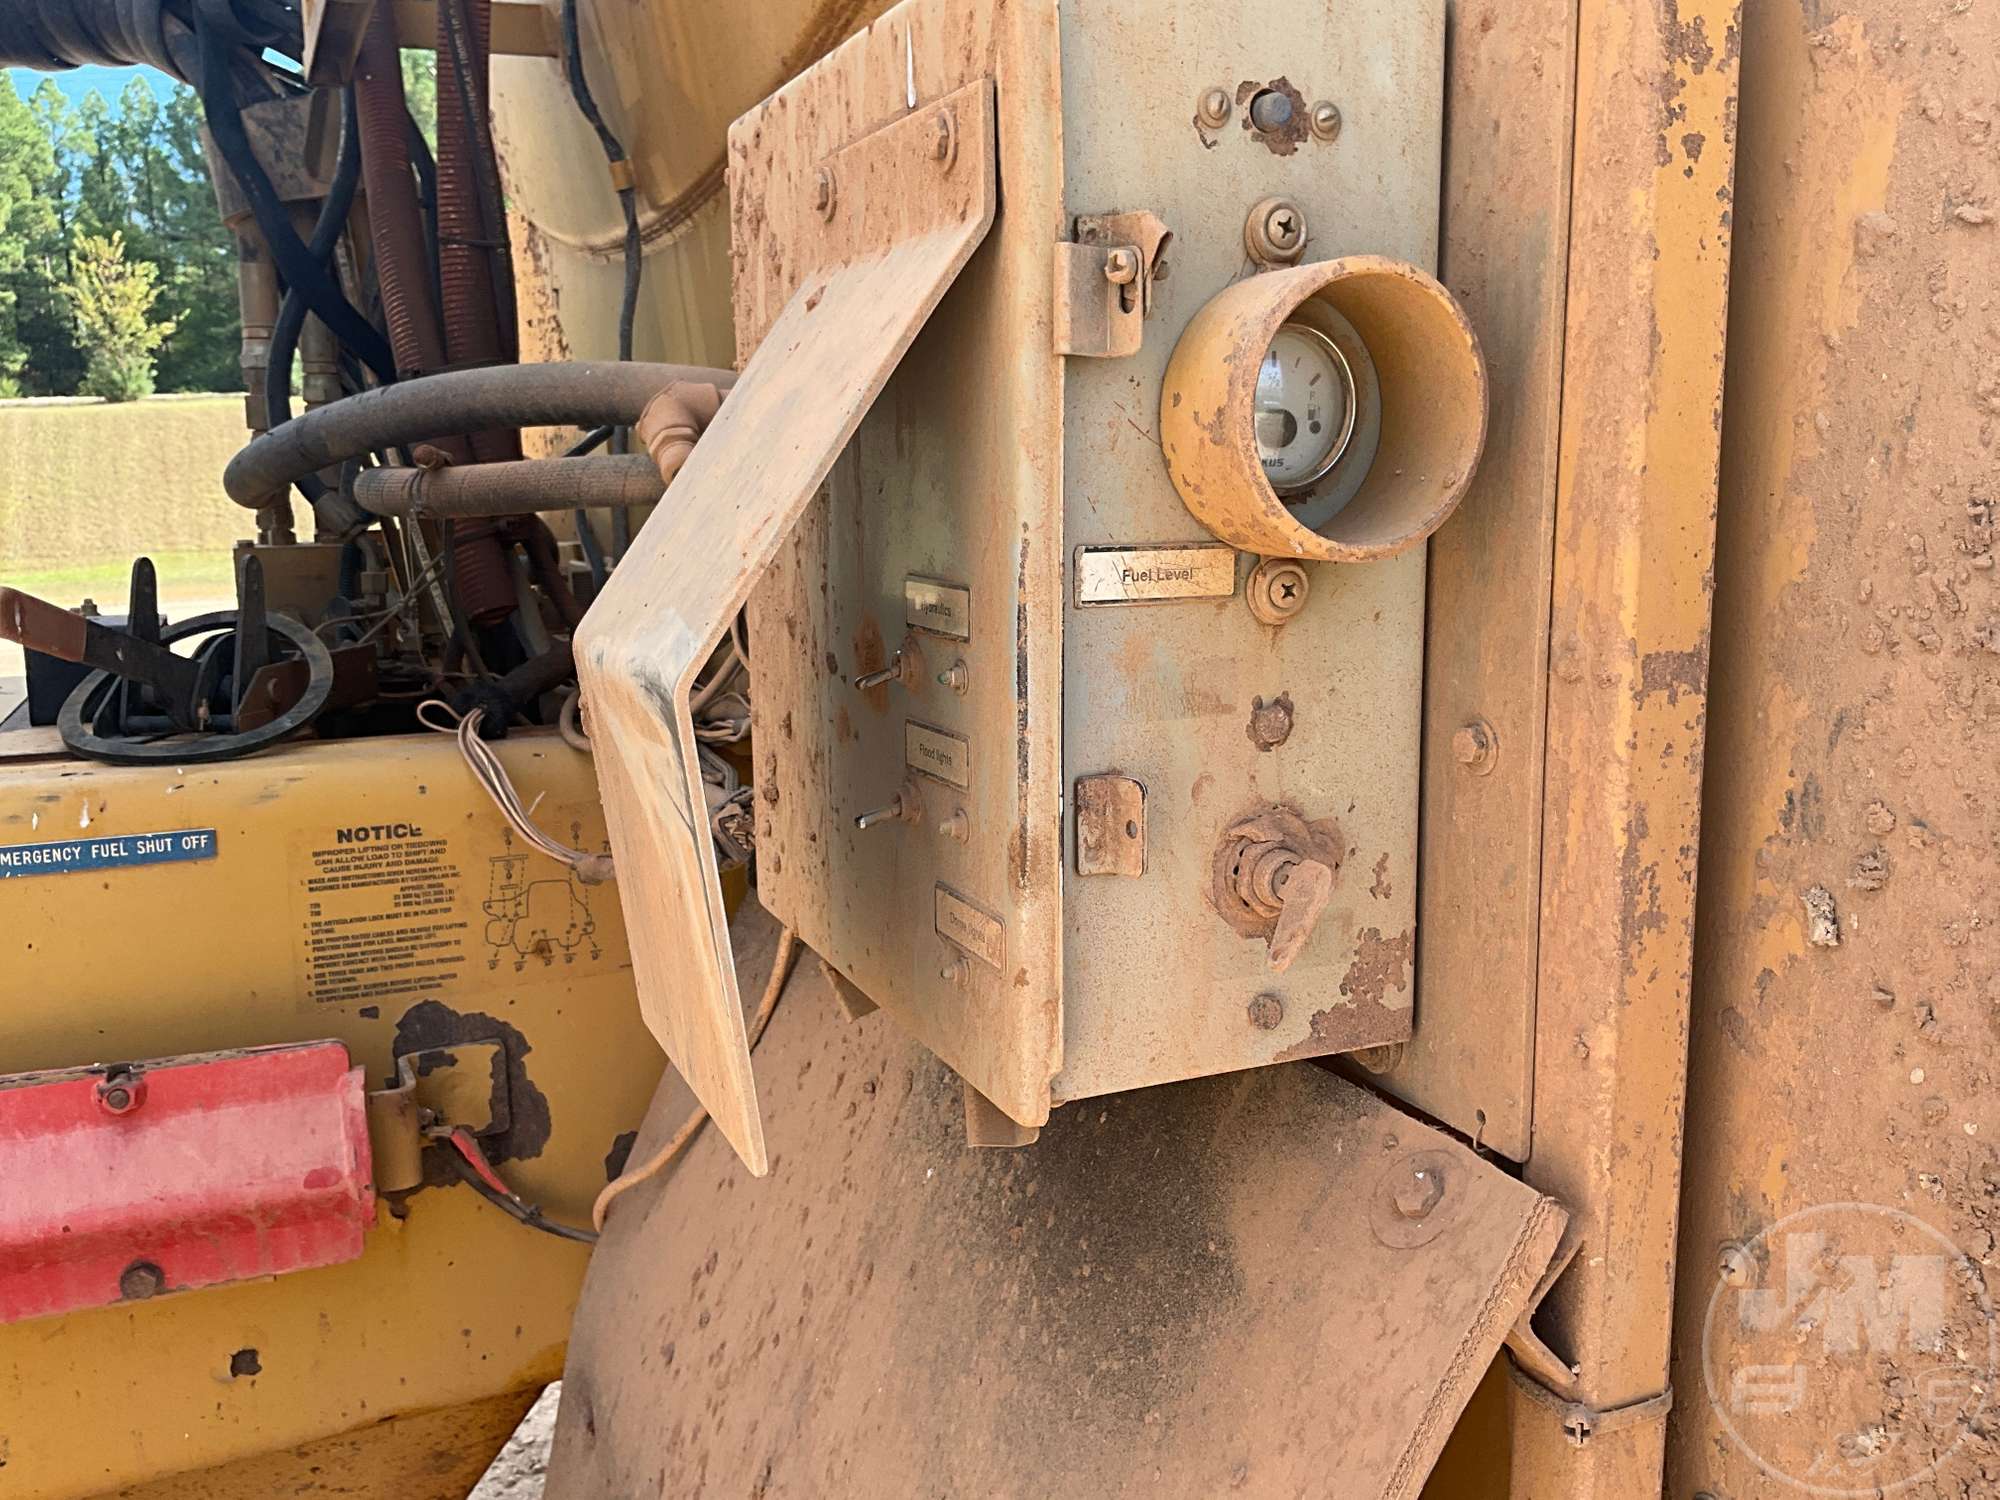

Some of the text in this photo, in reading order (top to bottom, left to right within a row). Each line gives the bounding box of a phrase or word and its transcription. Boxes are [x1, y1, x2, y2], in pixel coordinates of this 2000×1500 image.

[1122, 568, 1193, 582] Fuel Level
[919, 743, 952, 766] Flood lights
[337, 823, 423, 844] NOTICE
[91, 842, 128, 858] FUEL
[137, 838, 173, 855] SHUT
[182, 835, 208, 850] OFF
[358, 844, 389, 853] LIFTING
[314, 858, 332, 866] CAN
[334, 855, 364, 864] ALLOW
[366, 852, 389, 861] LOAD
[429, 847, 446, 855] AND
[322, 864, 351, 874] CAUSE
[385, 859, 403, 867] AND
